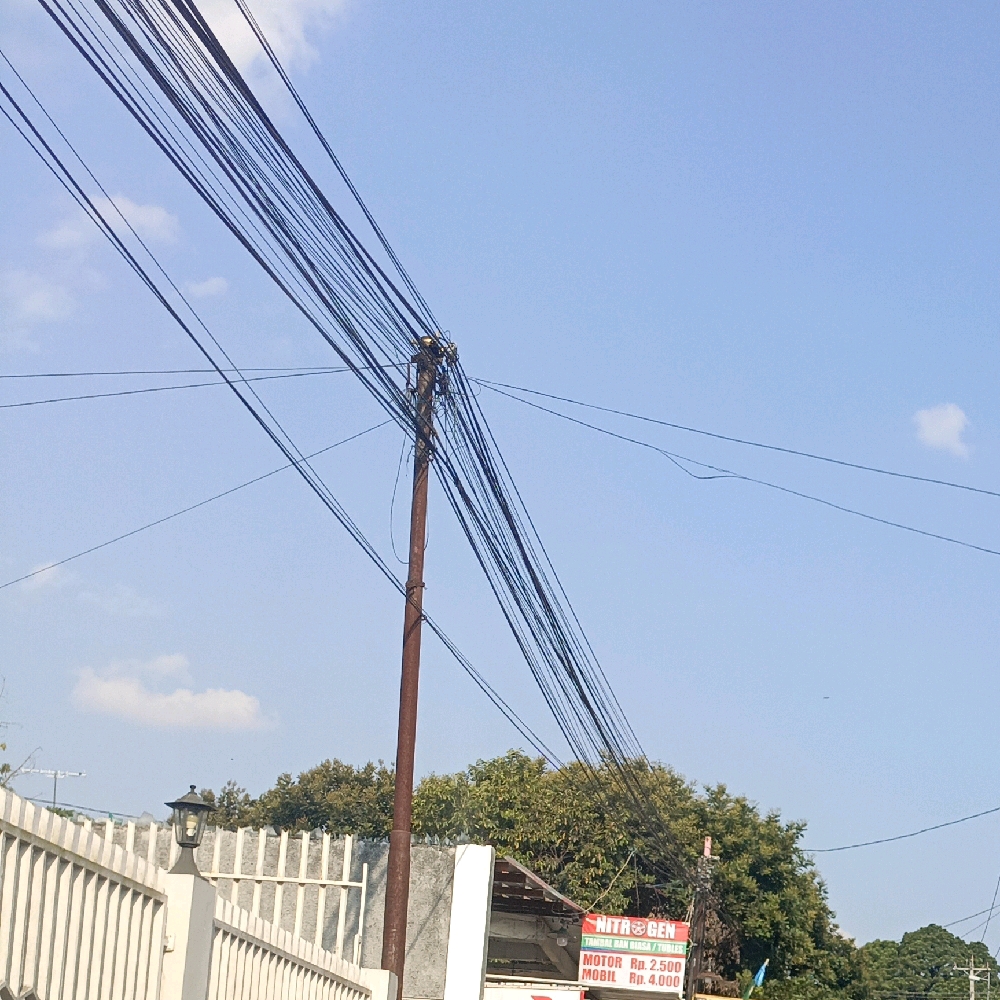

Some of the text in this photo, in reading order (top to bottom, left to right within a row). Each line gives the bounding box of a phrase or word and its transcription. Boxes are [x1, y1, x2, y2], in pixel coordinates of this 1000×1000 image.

[584, 937, 613, 948] TAMBAL
[613, 939, 629, 950] BAN
[629, 940, 652, 951] BIASA
[657, 943, 684, 954] TUBLES
[582, 954, 682, 973] MOTOR Rp. 2.500
[581, 968, 680, 987] MOBIL Rp. 4.000
